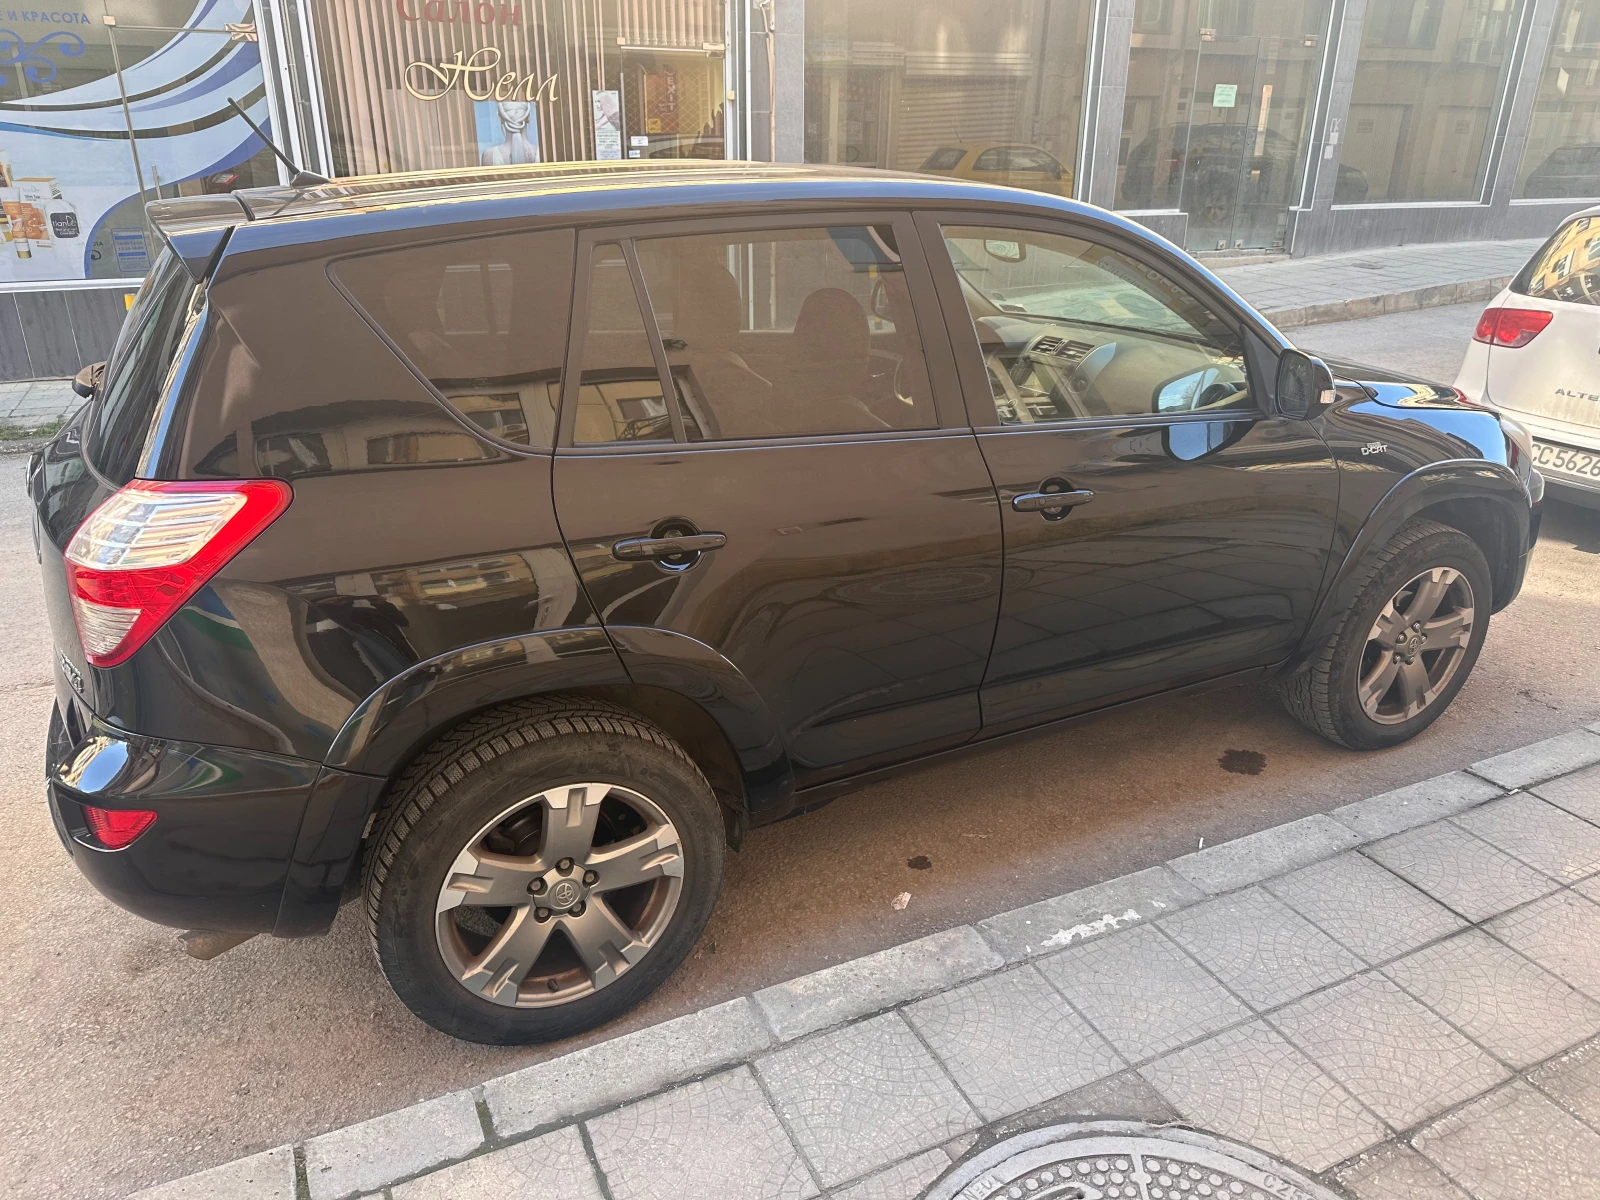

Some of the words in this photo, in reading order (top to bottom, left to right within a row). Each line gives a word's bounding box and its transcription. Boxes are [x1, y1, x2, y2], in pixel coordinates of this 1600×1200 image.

[7, 10, 18, 21] И
[21, 10, 91, 25] КРАСОТА
[397, 0, 521, 26] Салон
[1554, 387, 1600, 403] ALTE
